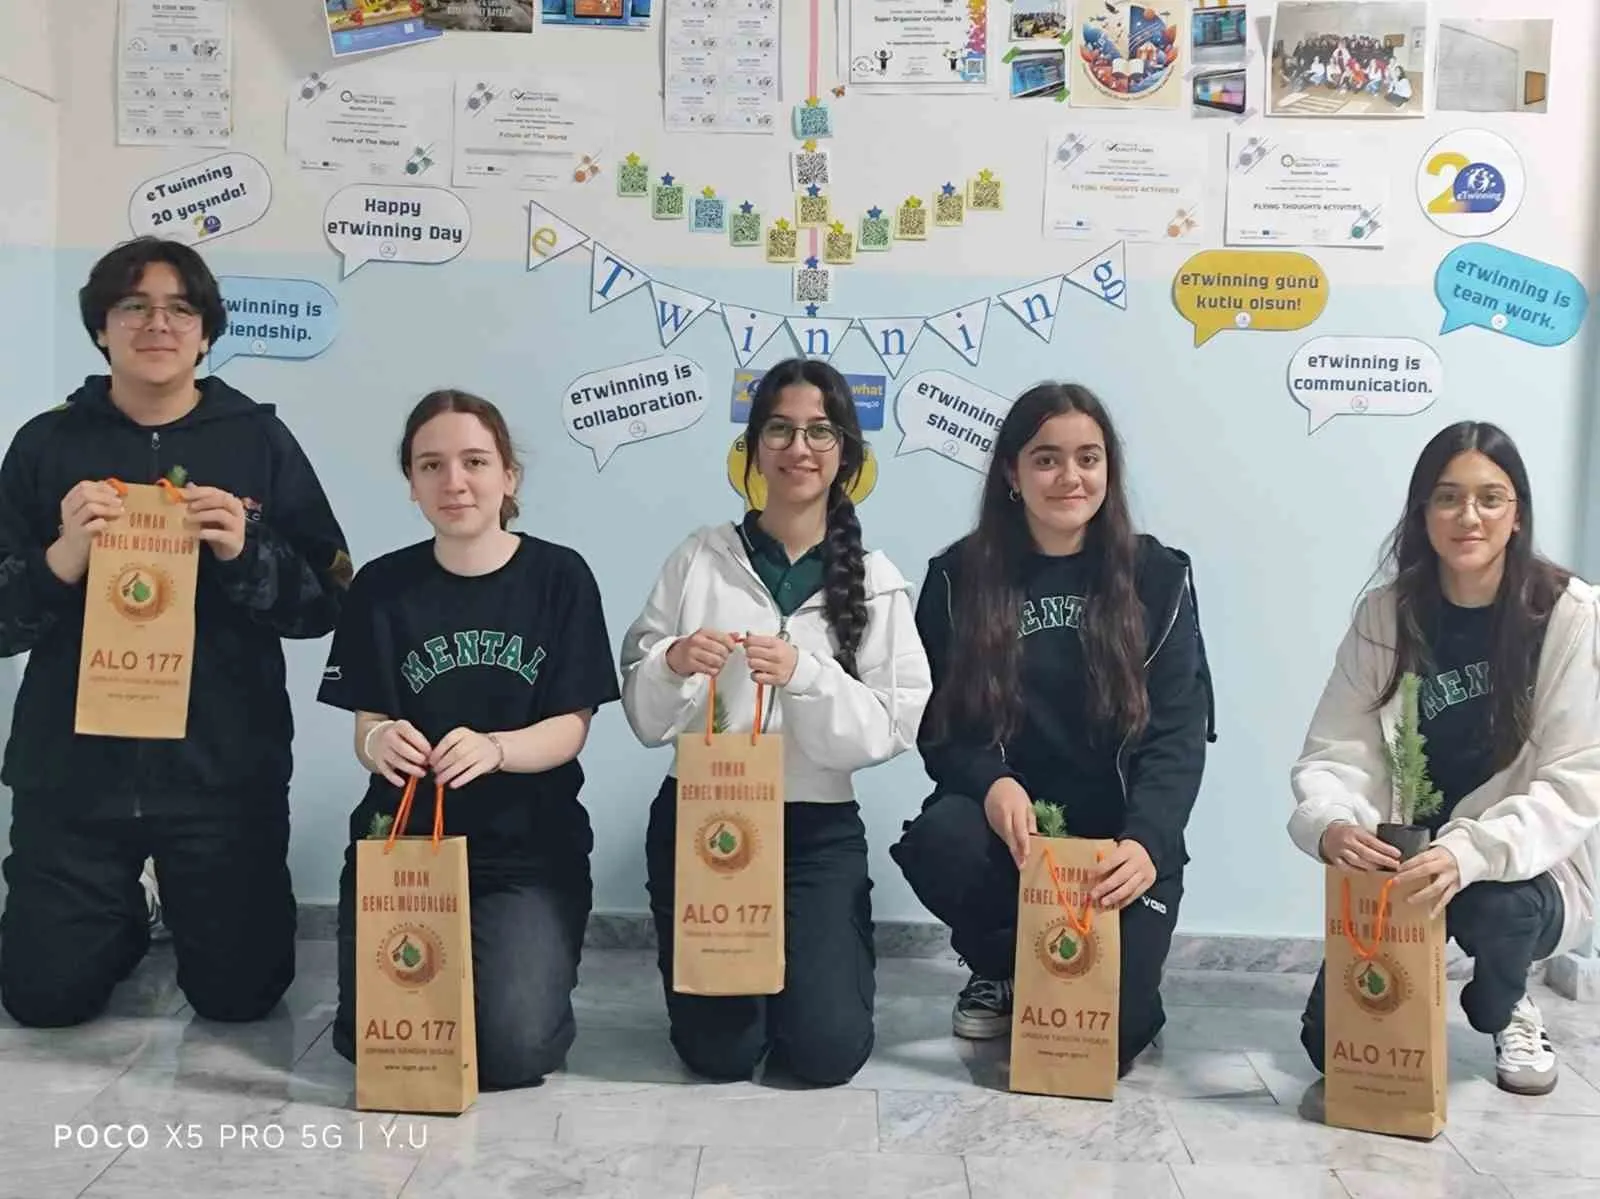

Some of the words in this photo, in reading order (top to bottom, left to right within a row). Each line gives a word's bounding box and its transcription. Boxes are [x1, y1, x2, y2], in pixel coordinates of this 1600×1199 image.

[146, 165, 233, 201] eTwinning
[152, 208, 172, 225] 20
[177, 182, 247, 220] yaşında!
[364, 198, 421, 217] Happy
[1456, 191, 1502, 202] eTwinning
[327, 221, 422, 241] eTwinning
[429, 226, 463, 243] Day
[1180, 272, 1268, 293] eTwinning
[1275, 274, 1319, 291] günü
[1455, 259, 1549, 302] eTwinning
[1553, 292, 1572, 308] is
[222, 298, 299, 318] winning
[306, 301, 322, 316] is
[1196, 295, 1243, 310] kutlu
[1250, 297, 1302, 311] olsun!
[1453, 284, 1499, 311] team
[1505, 302, 1556, 330] work.
[229, 321, 312, 342] iendship.
[1307, 354, 1399, 371] eTwinning
[1405, 355, 1421, 370] is
[570, 370, 669, 405] eTwinning
[674, 364, 692, 379] is
[1293, 377, 1434, 393] communication.
[572, 389, 703, 430] collaboration.
[917, 381, 1005, 432] eTwinning
[129, 511, 166, 529] ORMAN
[1020, 595, 1087, 636] ENT
[90, 649, 138, 670] ALO
[146, 653, 183, 673] 177
[400, 630, 547, 694] MENTAL
[1423, 661, 1489, 720] MEN
[393, 870, 430, 888] ORMAN
[362, 895, 395, 912] GENEL
[1023, 887, 1054, 905] GENEL
[682, 903, 729, 924] ALO
[736, 905, 773, 924] 177
[1020, 1005, 1067, 1028] ALO
[1075, 1010, 1111, 1031] 177
[364, 1018, 413, 1041] ALO
[421, 1020, 457, 1041] 177
[1332, 1040, 1380, 1065] ALO
[1387, 1048, 1426, 1069] 177
